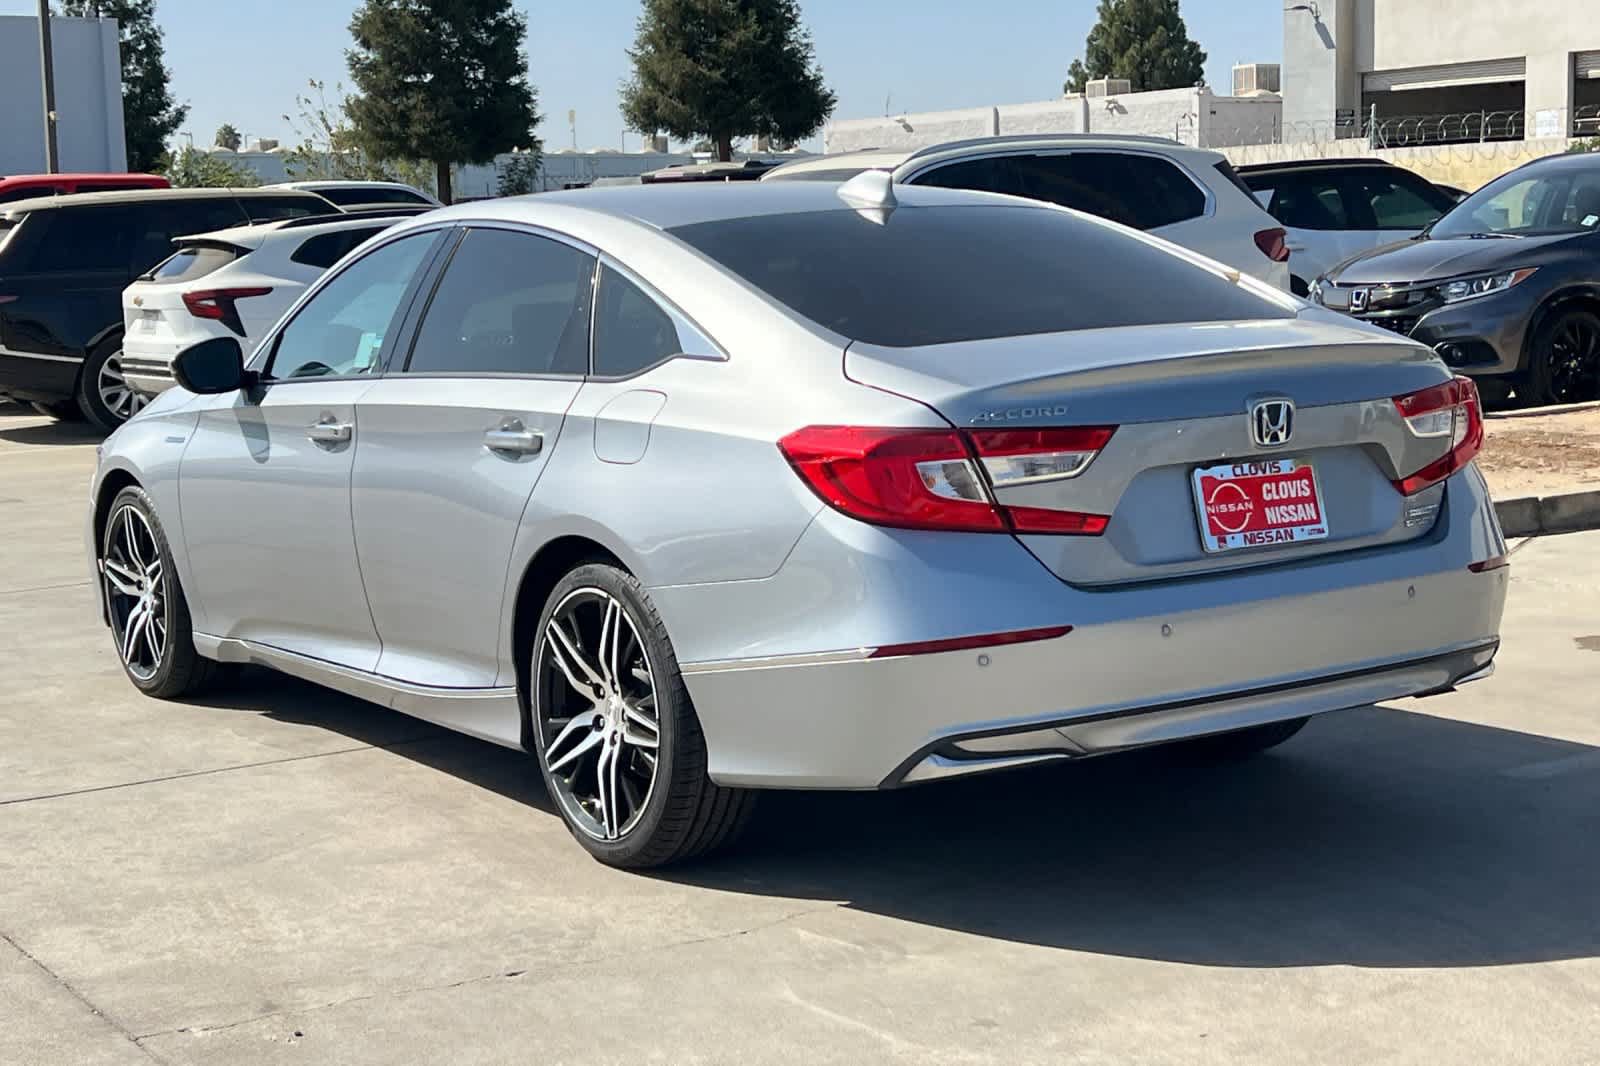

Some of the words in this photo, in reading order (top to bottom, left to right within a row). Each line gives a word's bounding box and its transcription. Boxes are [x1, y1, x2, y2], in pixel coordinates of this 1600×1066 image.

[970, 405, 1067, 422] ACCORD
[1232, 461, 1281, 477] CLOVIS
[1262, 479, 1311, 501] CLOVIS
[1207, 501, 1253, 514] NISSAN
[1265, 503, 1317, 524] NISSAN
[1243, 528, 1295, 546] NISSAN
